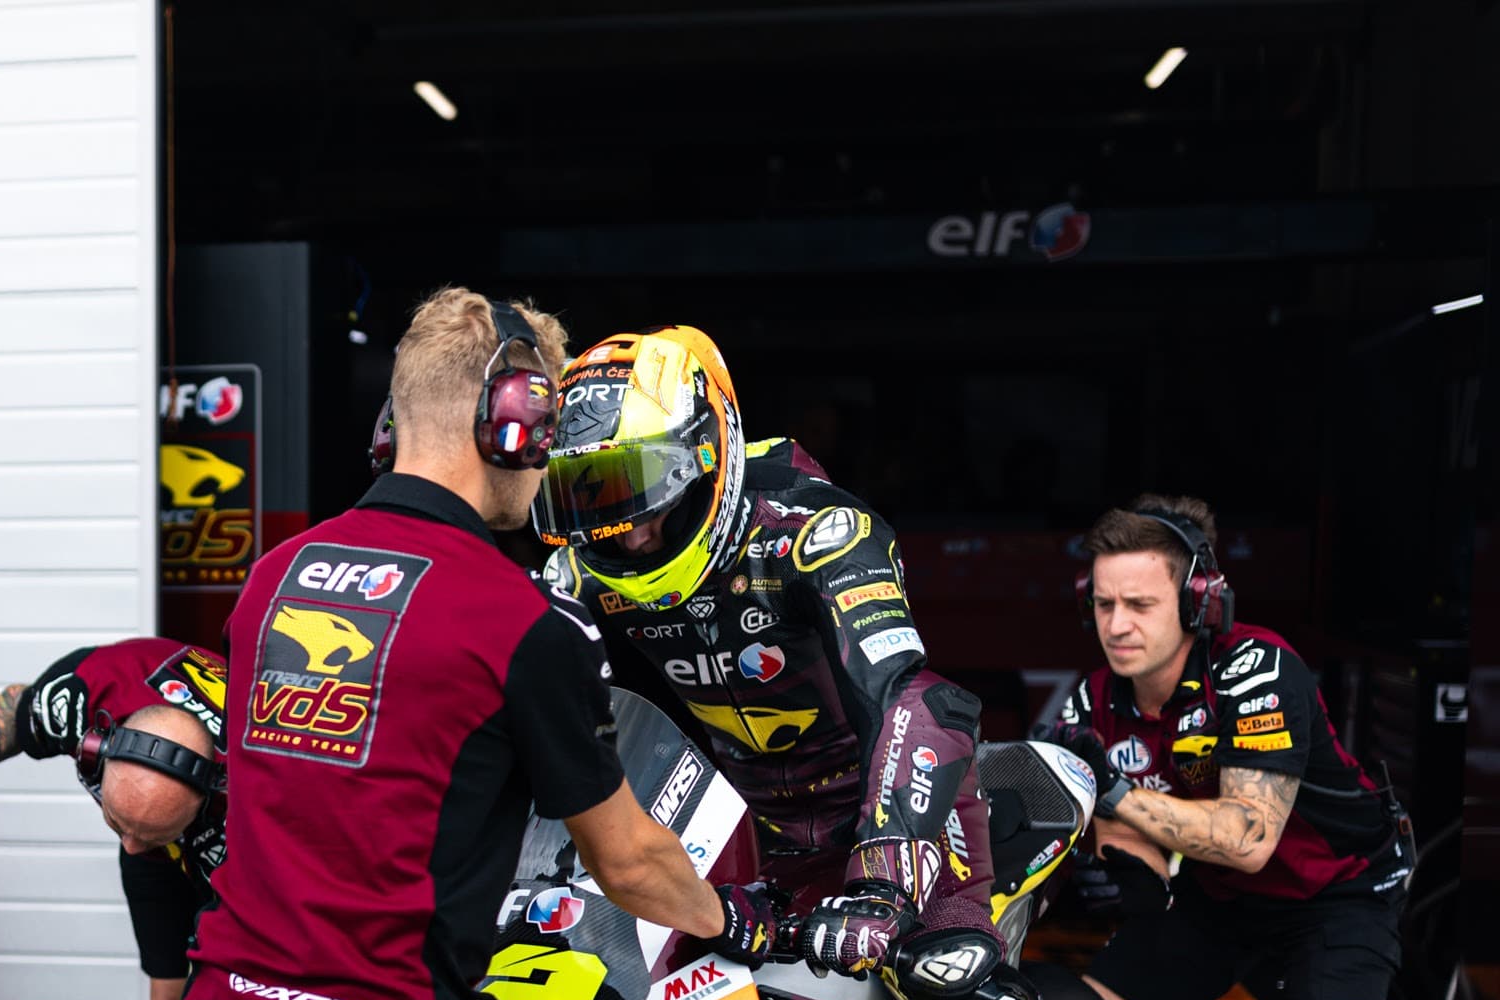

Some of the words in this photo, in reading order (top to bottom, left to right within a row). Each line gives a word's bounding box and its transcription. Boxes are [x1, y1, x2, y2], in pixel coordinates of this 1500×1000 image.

[926, 211, 1030, 256] elf
[603, 520, 633, 537] Beta
[548, 534, 568, 547] Beta
[298, 561, 364, 592] elf
[842, 584, 899, 607] PIRELLI
[261, 669, 323, 690] marc
[664, 651, 734, 686] elf
[1238, 698, 1265, 715] elf
[1177, 715, 1192, 732] lf
[1252, 718, 1282, 730] Beta
[252, 730, 301, 746] RACING
[311, 739, 357, 754] TEAM
[654, 755, 700, 825] WRS
[910, 769, 933, 814] elf
